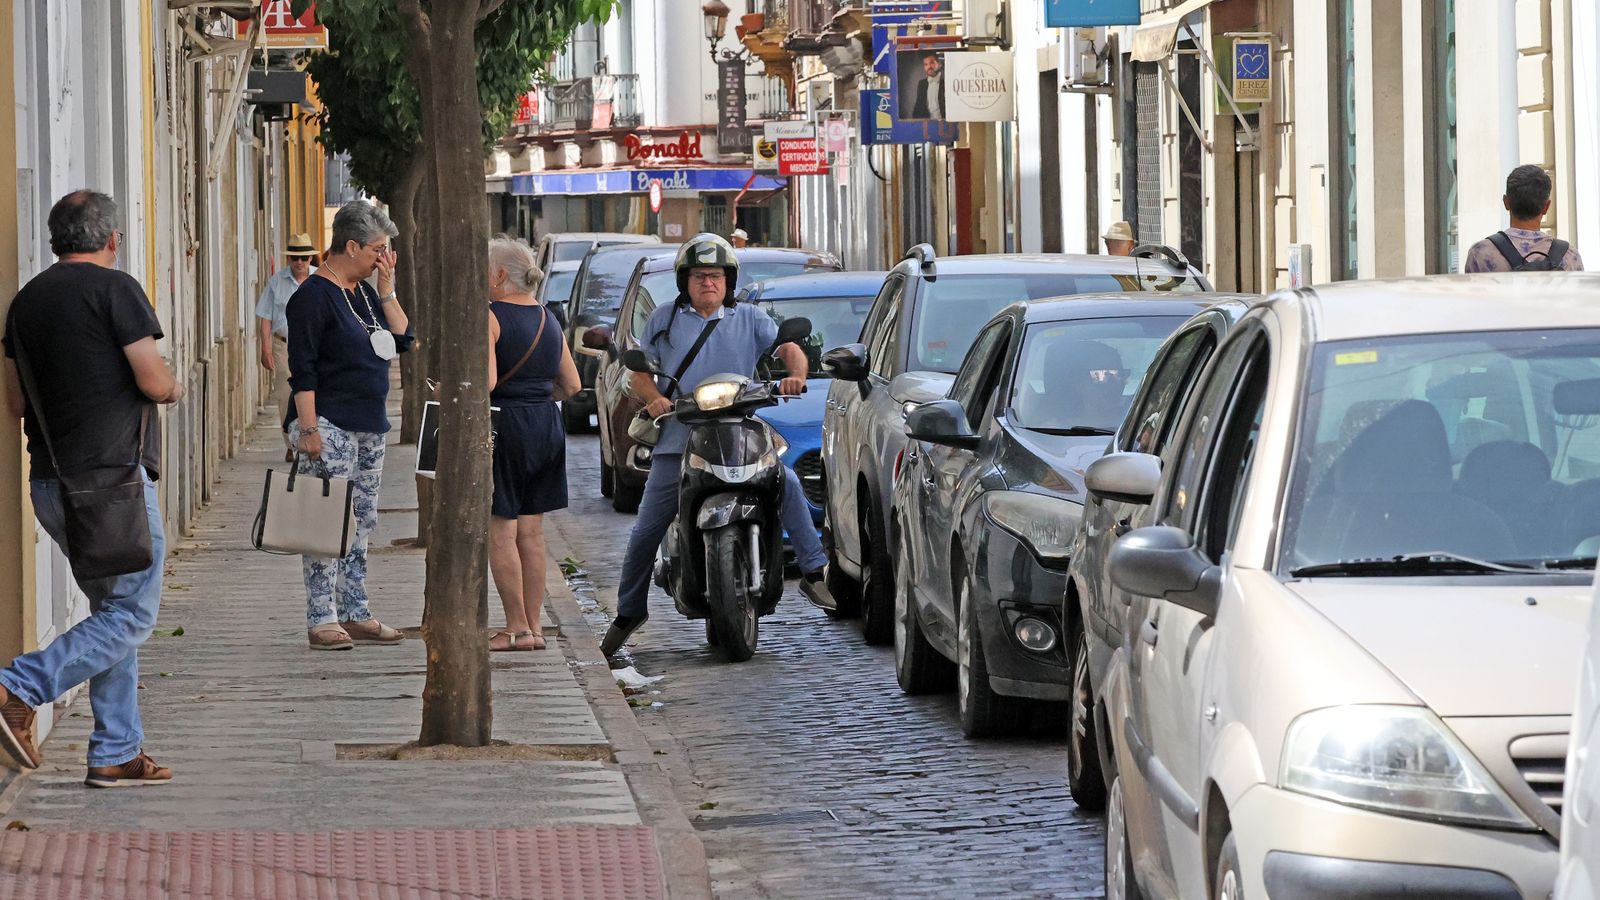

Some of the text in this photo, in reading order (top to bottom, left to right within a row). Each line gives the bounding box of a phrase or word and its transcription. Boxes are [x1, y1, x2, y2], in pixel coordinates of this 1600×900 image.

[974, 68, 985, 78] LA
[1239, 80, 1267, 89] JEREZ
[721, 132, 735, 146] Los
[624, 130, 703, 160] Donald
[780, 141, 817, 150] CONDUCTO
